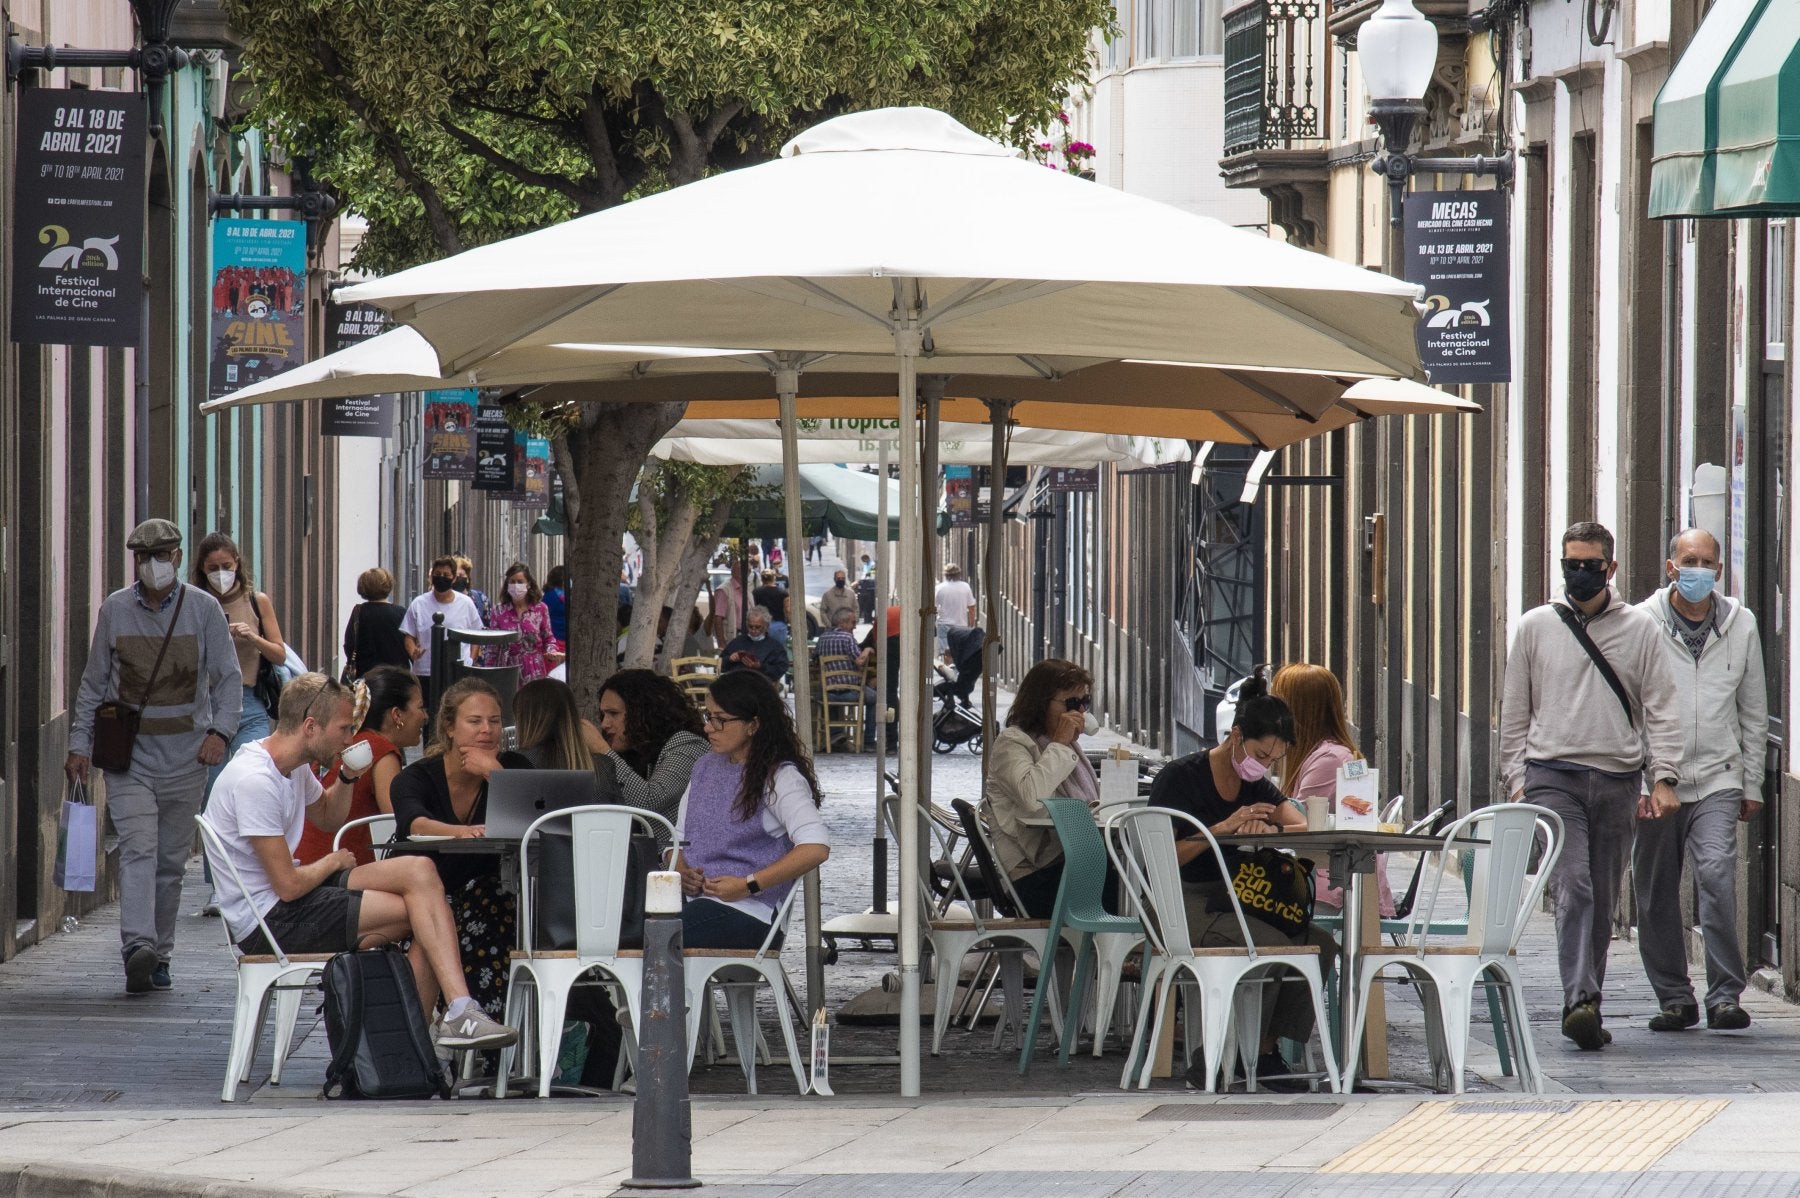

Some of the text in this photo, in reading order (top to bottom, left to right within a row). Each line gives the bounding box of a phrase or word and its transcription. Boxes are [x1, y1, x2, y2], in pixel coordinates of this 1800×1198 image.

[54, 108, 126, 130] 9 AL 18 DE
[40, 131, 121, 154] ABRIL 2021
[54, 165, 64, 178] TO
[81, 166, 102, 179] APRIL
[104, 167, 124, 180] 2021
[1431, 201, 1478, 220] MECAS
[1417, 220, 1442, 228] MERCADO
[1442, 220, 1451, 228] DEL
[1464, 219, 1476, 227] CASI
[226, 227, 295, 238] 9 AL 18 DE ABRIL 2021
[1419, 243, 1494, 255] 10 AL 13 DE ABRIL 2021
[1440, 256, 1446, 264] TO
[1456, 256, 1470, 264] APRIL
[1471, 255, 1484, 264] 2021
[55, 275, 99, 286] Festival
[38, 285, 116, 297] Internacional
[55, 297, 98, 308] de Cine
[345, 310, 352, 322] 9
[352, 311, 362, 322] AL
[364, 311, 374, 322] 18
[224, 320, 294, 346] CINE
[337, 323, 360, 335] ABRIL
[1440, 331, 1476, 340] Festival
[1428, 339, 1490, 348] Internacional
[1442, 348, 1476, 356] de Cine
[482, 409, 503, 418] MECAS
[1240, 863, 1266, 878] No
[1233, 872, 1272, 895] Fun
[1227, 881, 1304, 924] Records
[460, 1019, 478, 1036] N
